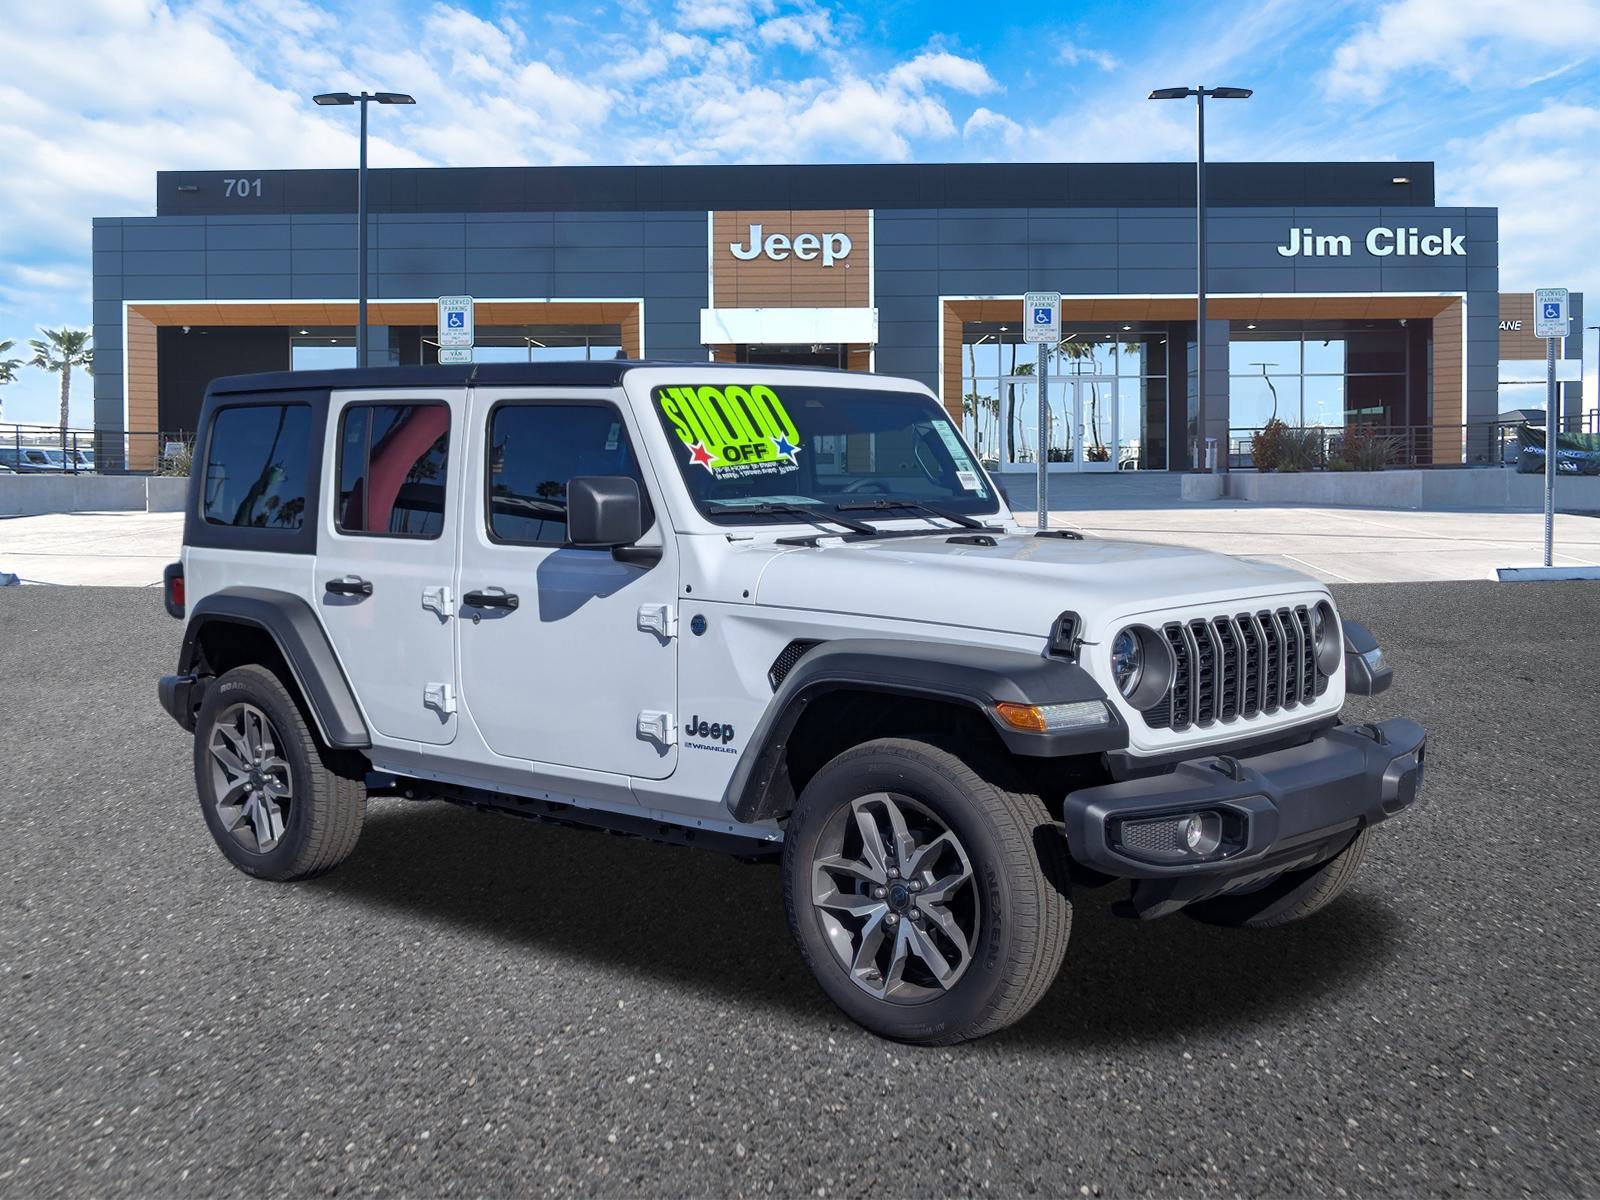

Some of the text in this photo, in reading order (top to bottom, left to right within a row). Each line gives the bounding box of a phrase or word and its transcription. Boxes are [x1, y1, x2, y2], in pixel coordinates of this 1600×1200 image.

[223, 178, 262, 197] 701
[729, 223, 852, 267] Jeep
[1277, 227, 1467, 257] Jim Click
[1498, 320, 1522, 331] ANE
[659, 385, 800, 447] $11000
[722, 443, 768, 463] OFF
[685, 714, 735, 745] Jeep
[692, 743, 738, 754] WRANGLER
